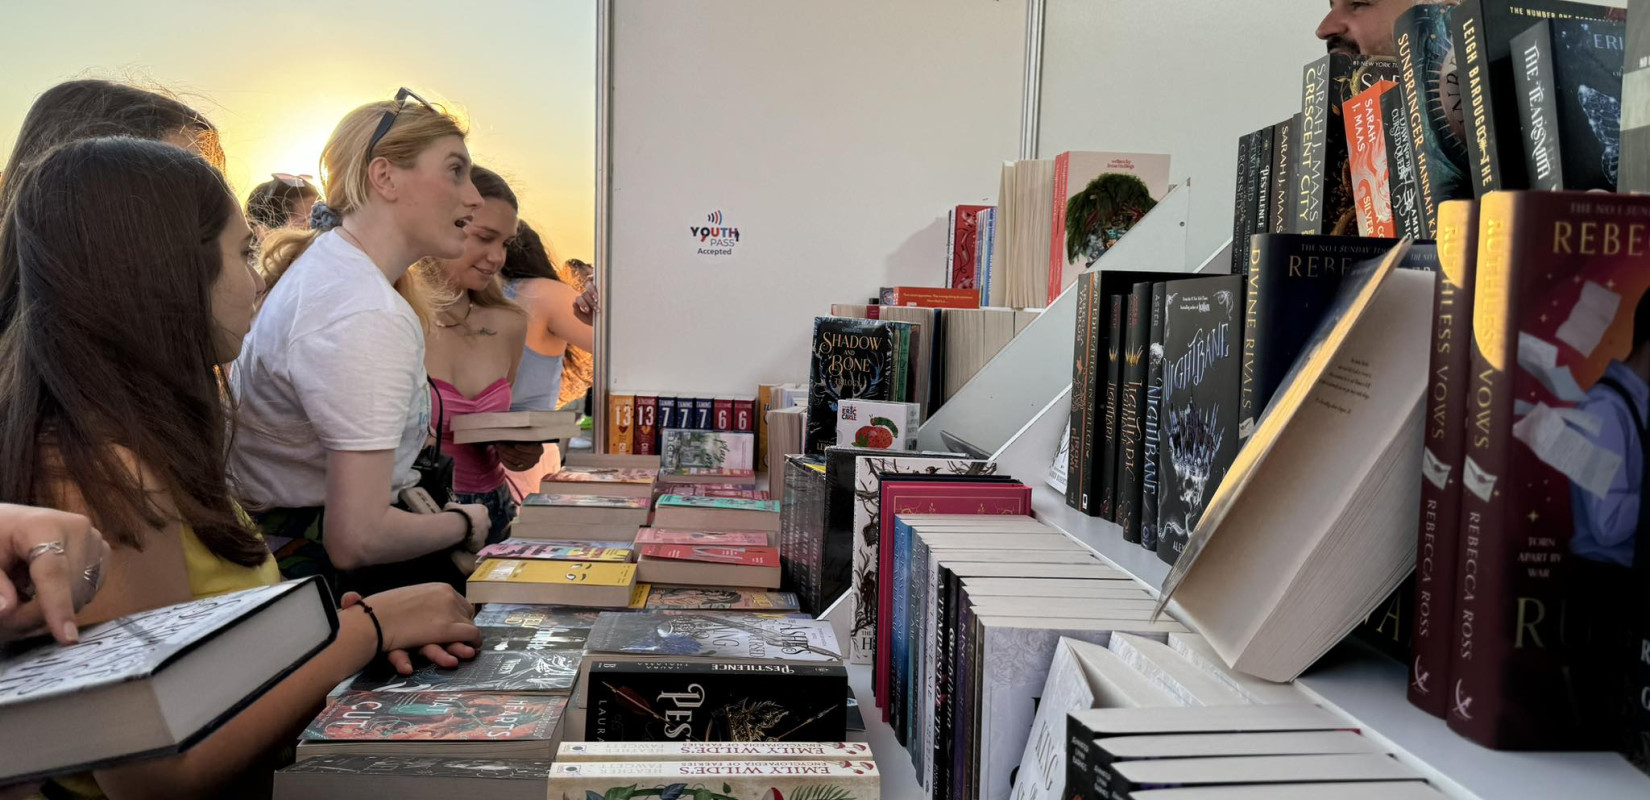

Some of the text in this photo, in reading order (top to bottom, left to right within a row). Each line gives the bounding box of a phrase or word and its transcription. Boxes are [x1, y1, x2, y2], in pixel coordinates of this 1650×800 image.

[1510, 6, 1523, 15] THE
[1462, 18, 1478, 64] LEIGH
[1523, 40, 1541, 82] THE
[1301, 68, 1316, 169] CRESCENT
[1353, 115, 1365, 152] MAAS
[1364, 98, 1376, 143] SARAH
[1389, 108, 1401, 147] CURSED
[1397, 32, 1423, 150] SUNBRINGER
[1417, 152, 1433, 215] HANNAH
[1309, 63, 1326, 222] SARAH J. MAAS
[1275, 125, 1290, 233] SARAH J. MAAS
[1480, 155, 1493, 187] THE
[1258, 164, 1270, 228] PESTILENCE
[1299, 175, 1311, 221] CITY
[1362, 195, 1374, 237] SILVER
[690, 226, 740, 242] YOUTH
[710, 238, 735, 247] PASS
[1301, 243, 1316, 252] THE
[697, 247, 732, 256] Accepted
[1153, 294, 1161, 327] ASTER
[819, 331, 883, 354] SHADOW
[1241, 248, 1261, 409] DIVINE RIVALS
[1432, 224, 1460, 440] RUTHLESS VOWS
[1474, 217, 1505, 449] RUTHLESS VOWS
[828, 354, 871, 377] BONE
[1162, 321, 1230, 405] NIGHTBANE
[615, 405, 632, 427] 13
[638, 405, 654, 427] 13
[662, 407, 671, 428] 7
[681, 408, 689, 428] 7
[699, 408, 708, 428] 7
[718, 410, 727, 430] 6
[738, 410, 748, 430] 6
[1143, 376, 1162, 495] NIGHTBANE
[1517, 552, 1548, 563] APART
[1527, 536, 1555, 547] TORN
[1418, 499, 1438, 638] REBECCA ROSS
[1527, 567, 1550, 578] WAR
[1460, 511, 1481, 661] REBECCA ROSS
[778, 622, 814, 655] ASHES
[711, 662, 795, 675] PESTILENCE
[334, 701, 383, 728] CUT
[486, 699, 528, 739] HEARTS
[680, 746, 825, 754] EMILY WILDE'S
[679, 766, 831, 775] EMILY WILDE'S
